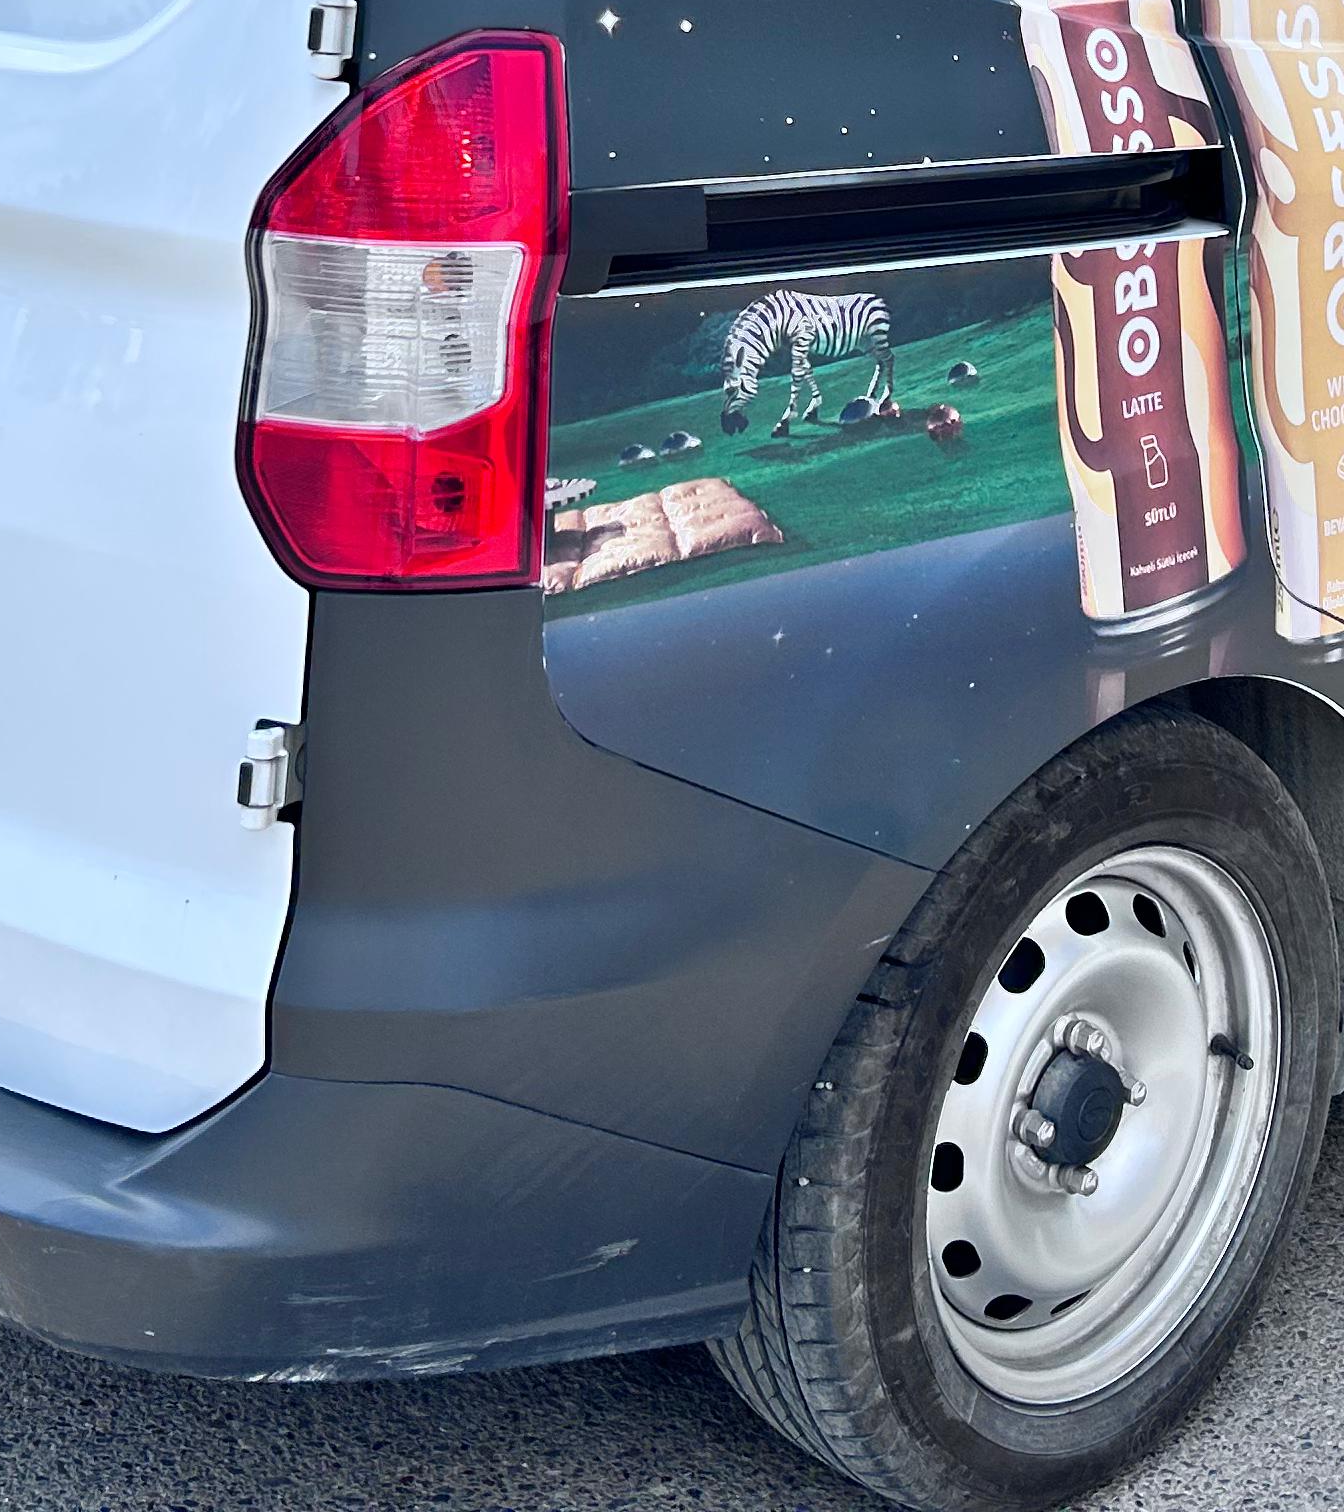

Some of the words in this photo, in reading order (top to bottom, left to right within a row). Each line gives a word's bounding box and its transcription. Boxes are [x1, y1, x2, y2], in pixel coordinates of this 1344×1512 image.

[1086, 27, 1161, 377] OBSSO
[1121, 391, 1164, 419] LATTE
[1144, 502, 1177, 527] SÜTLÜ
